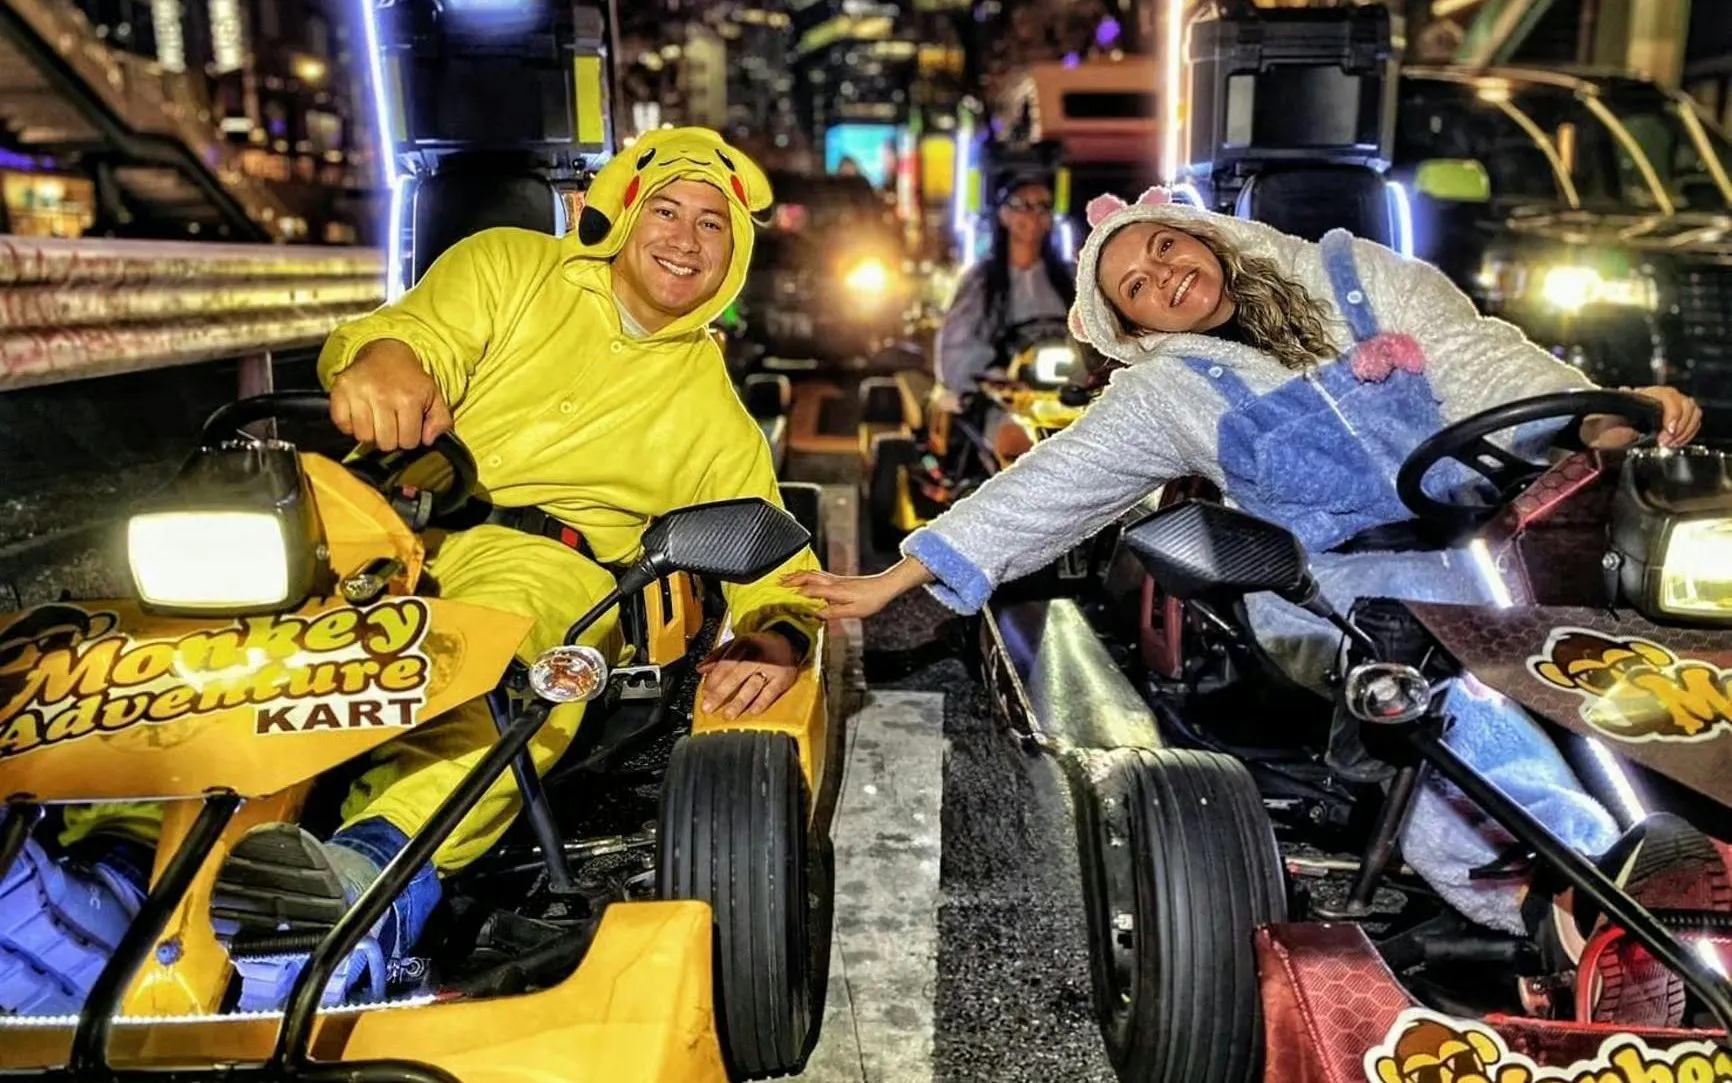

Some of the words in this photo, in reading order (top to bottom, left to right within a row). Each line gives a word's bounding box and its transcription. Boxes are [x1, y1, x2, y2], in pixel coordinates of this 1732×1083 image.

[0, 599, 427, 723] Monkey
[0, 655, 428, 757] Adventure
[256, 697, 423, 734] KART
